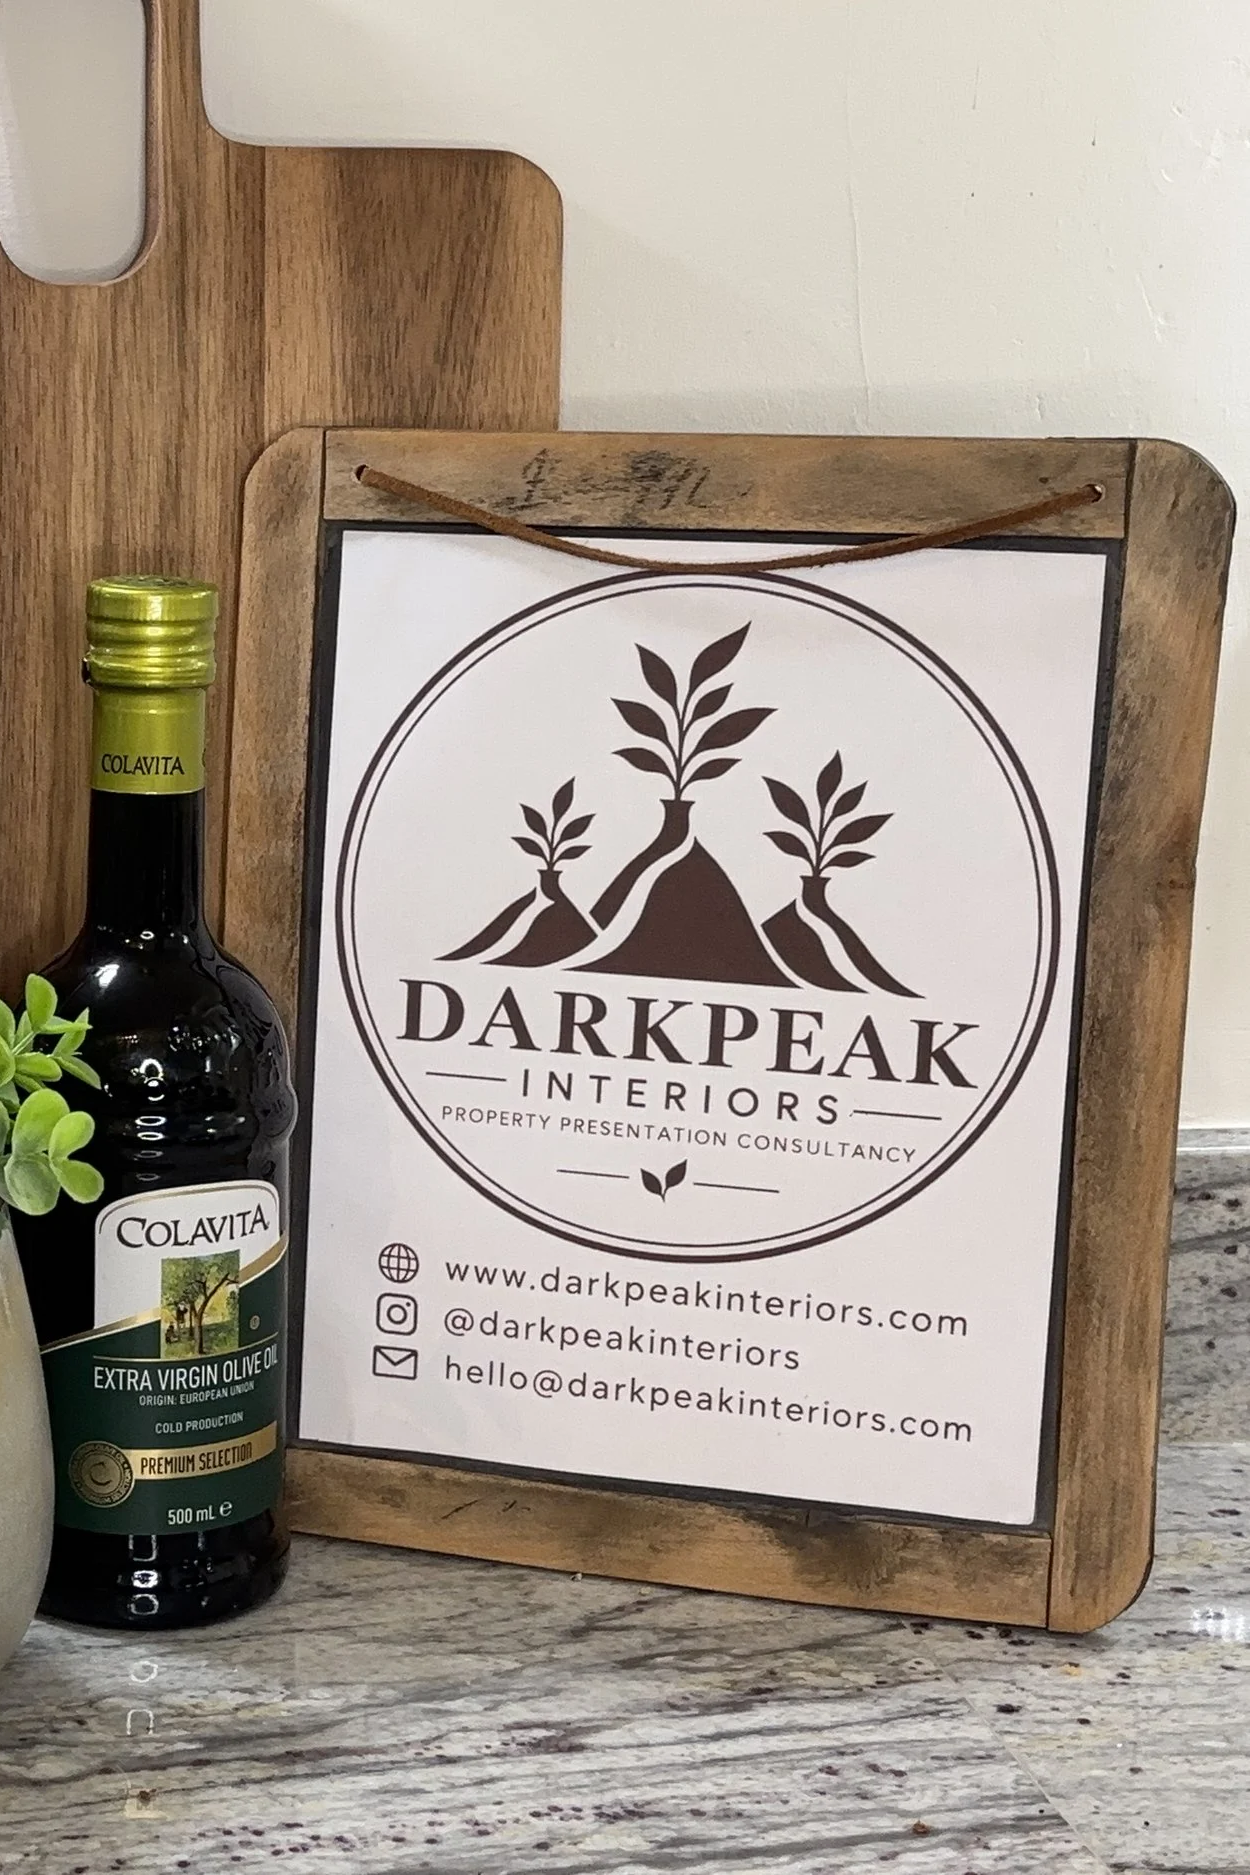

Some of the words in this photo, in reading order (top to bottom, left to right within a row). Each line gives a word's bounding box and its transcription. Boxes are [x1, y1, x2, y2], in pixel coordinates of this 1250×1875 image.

[101, 753, 185, 775] COLAVITA
[395, 978, 980, 1089] DARKPEAK
[521, 1067, 839, 1126] INTERIORS
[441, 1104, 551, 1131] PROPERTY
[559, 1116, 728, 1147] PRESENTATION
[736, 1132, 917, 1164] CONSULTANCY
[116, 1202, 269, 1249] COLAVITA
[444, 1260, 968, 1338] www.darkpeakinteriors.com
[443, 1306, 800, 1370] @darkpeakinteriors
[93, 1366, 152, 1391] EXTRA
[157, 1363, 218, 1391] VIRGIN
[222, 1350, 263, 1383] OLIVE
[263, 1343, 279, 1370] OIL
[138, 1394, 178, 1407] ORIGIN:
[179, 1388, 229, 1405] EUROPEAN
[229, 1380, 255, 1397] UNION
[444, 1353, 973, 1444] hello@darkpeakinteriors.com
[154, 1420, 184, 1435] COLD
[185, 1411, 245, 1432] PRODUCTION
[140, 1454, 195, 1475] PREMIUM
[199, 1441, 253, 1471] SELECTION
[167, 1507, 193, 1525] 500
[196, 1504, 216, 1522] mL
